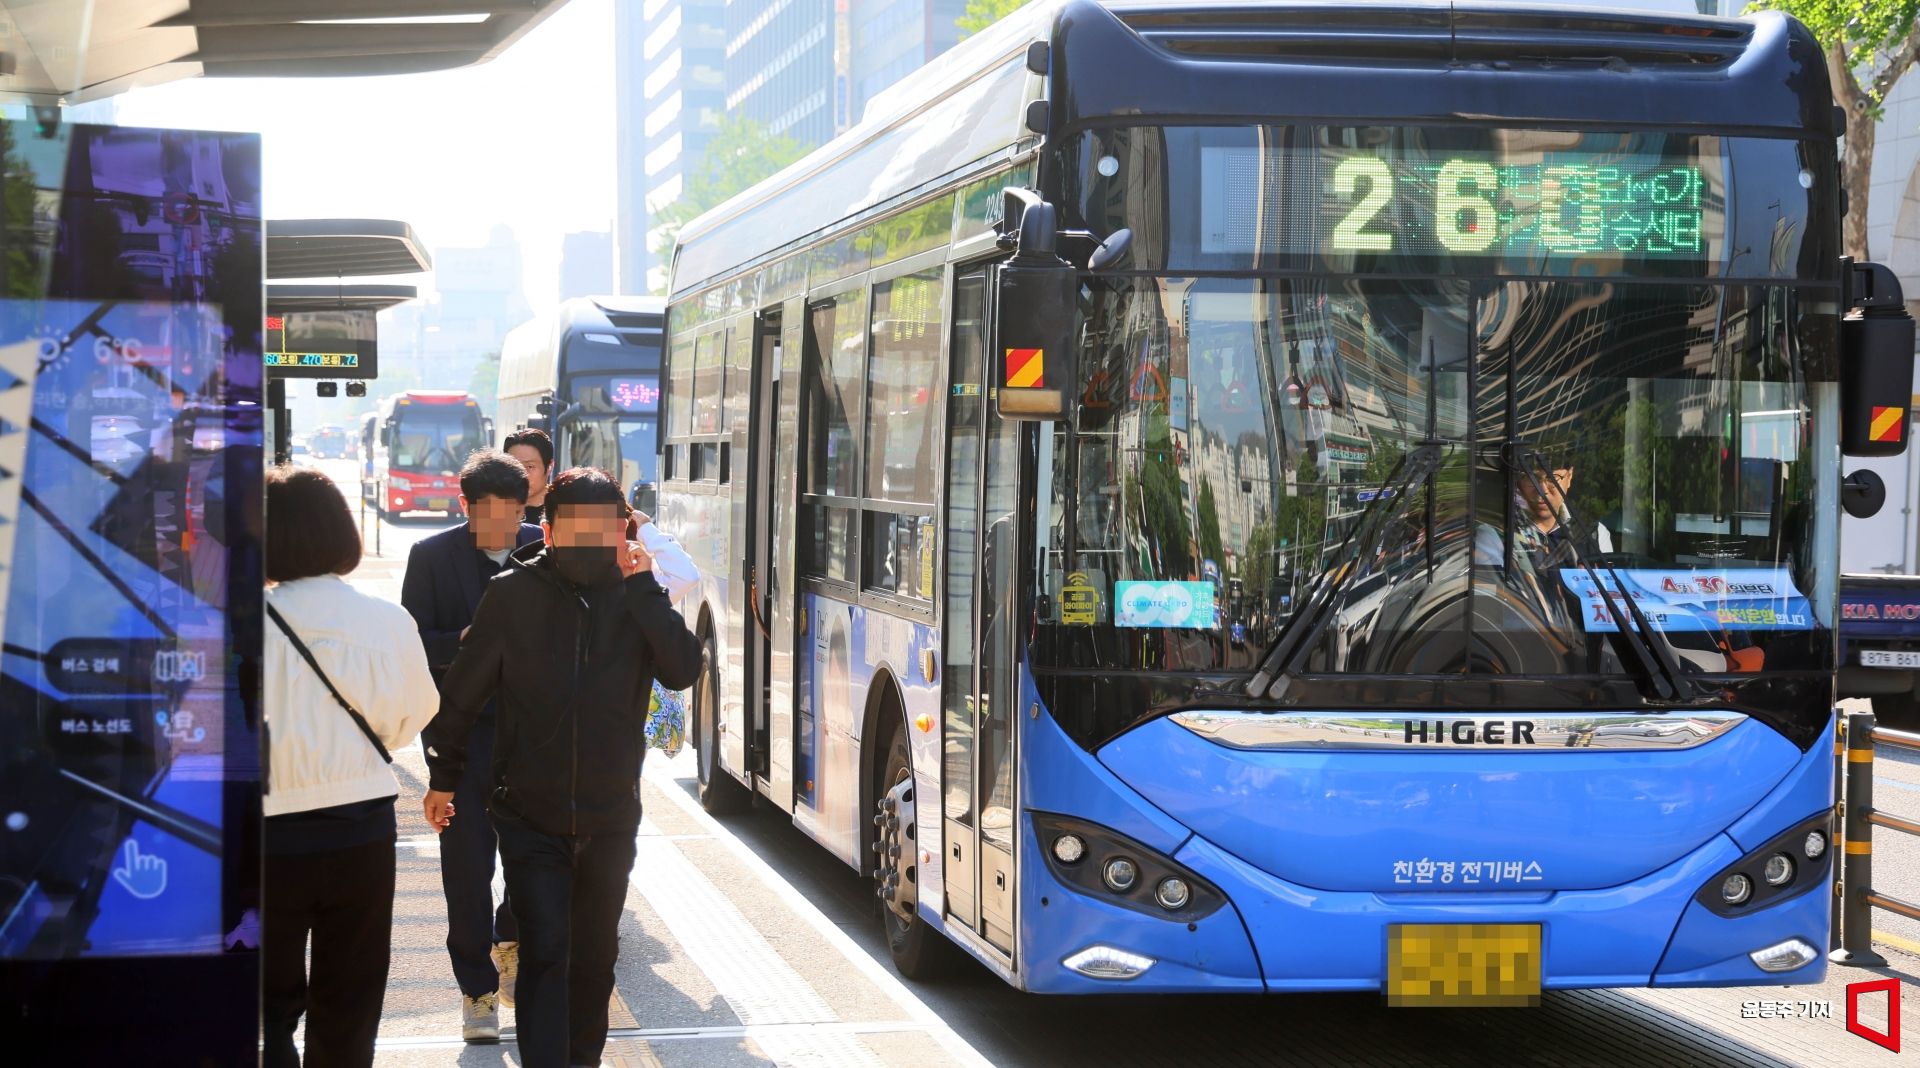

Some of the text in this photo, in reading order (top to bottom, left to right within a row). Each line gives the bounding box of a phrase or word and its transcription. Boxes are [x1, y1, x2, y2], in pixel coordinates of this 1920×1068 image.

[1126, 600, 1163, 608] CLIMATE
[1842, 603, 1881, 619] KIA
[61, 658, 120, 673] 버스 검색
[61, 718, 132, 734] 버스 노선도
[1404, 720, 1536, 745] HIGER
[1393, 857, 1543, 884] 친환경 전기버스
